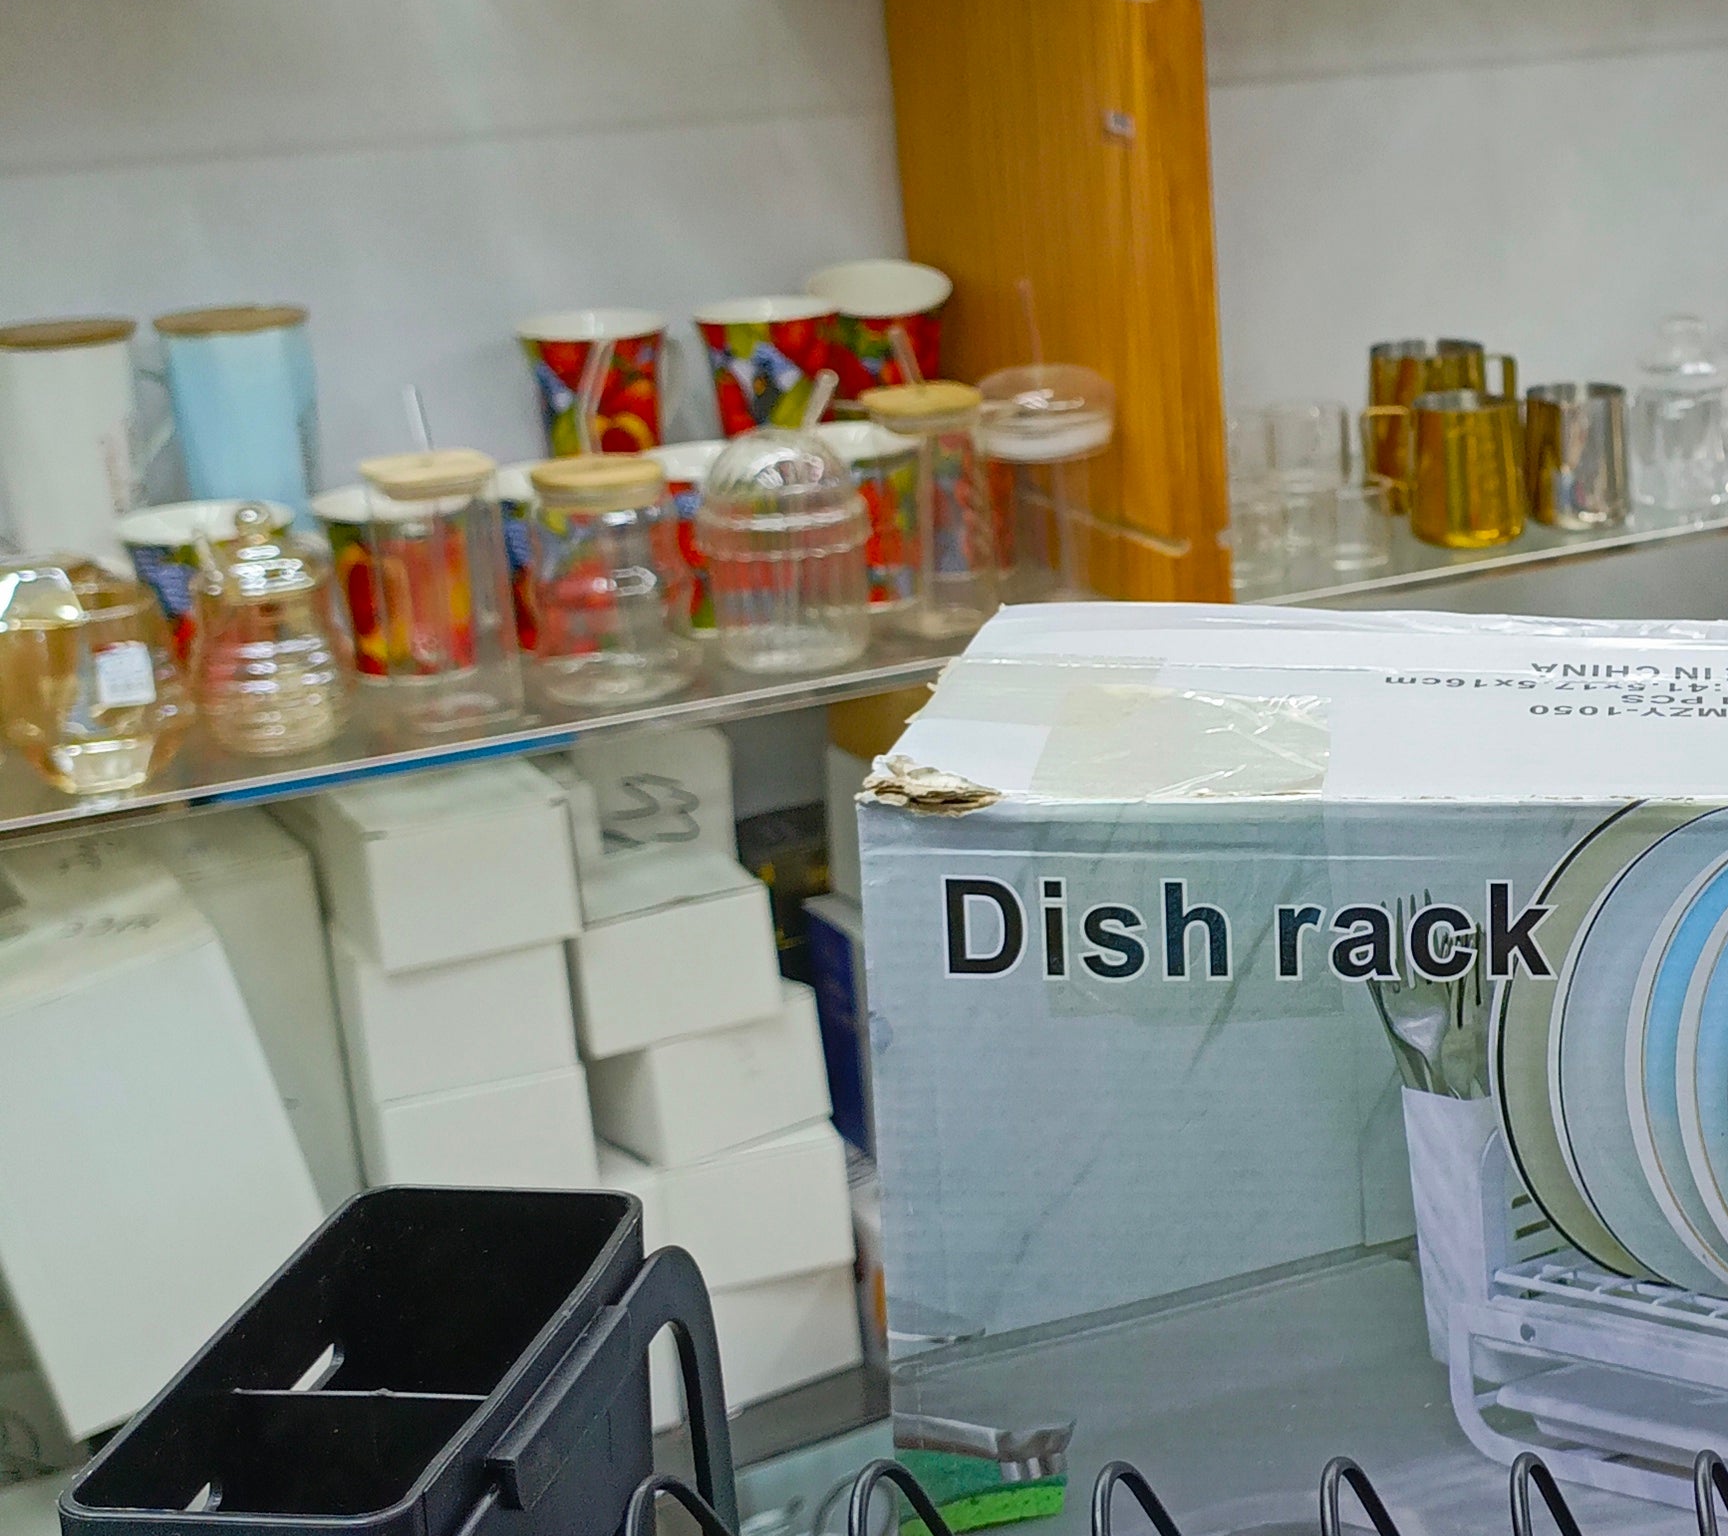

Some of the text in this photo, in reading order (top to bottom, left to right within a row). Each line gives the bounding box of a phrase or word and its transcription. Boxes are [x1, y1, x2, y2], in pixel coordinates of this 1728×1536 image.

[1530, 663, 1661, 678] CHINA
[1674, 666, 1712, 680] IN
[1621, 695, 1704, 705] PCS
[942, 875, 1558, 982] Dish rack
